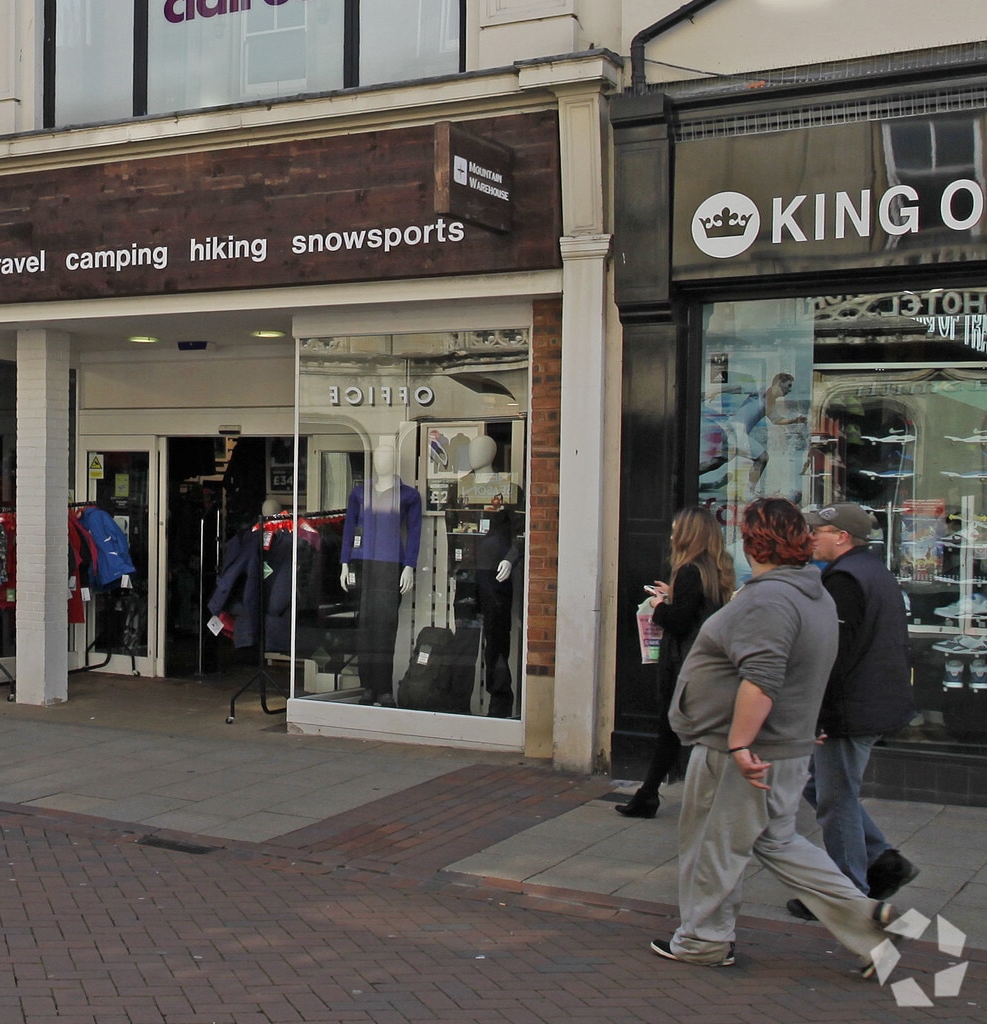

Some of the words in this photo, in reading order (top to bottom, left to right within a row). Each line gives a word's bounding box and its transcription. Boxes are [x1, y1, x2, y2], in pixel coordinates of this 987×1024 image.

[469, 161, 503, 184] MOUNTAIN
[469, 176, 510, 202] WAREHOUSE
[771, 184, 920, 244] KING
[65, 242, 169, 272] camping
[189, 235, 267, 263] hiking
[291, 218, 466, 255] snowsports
